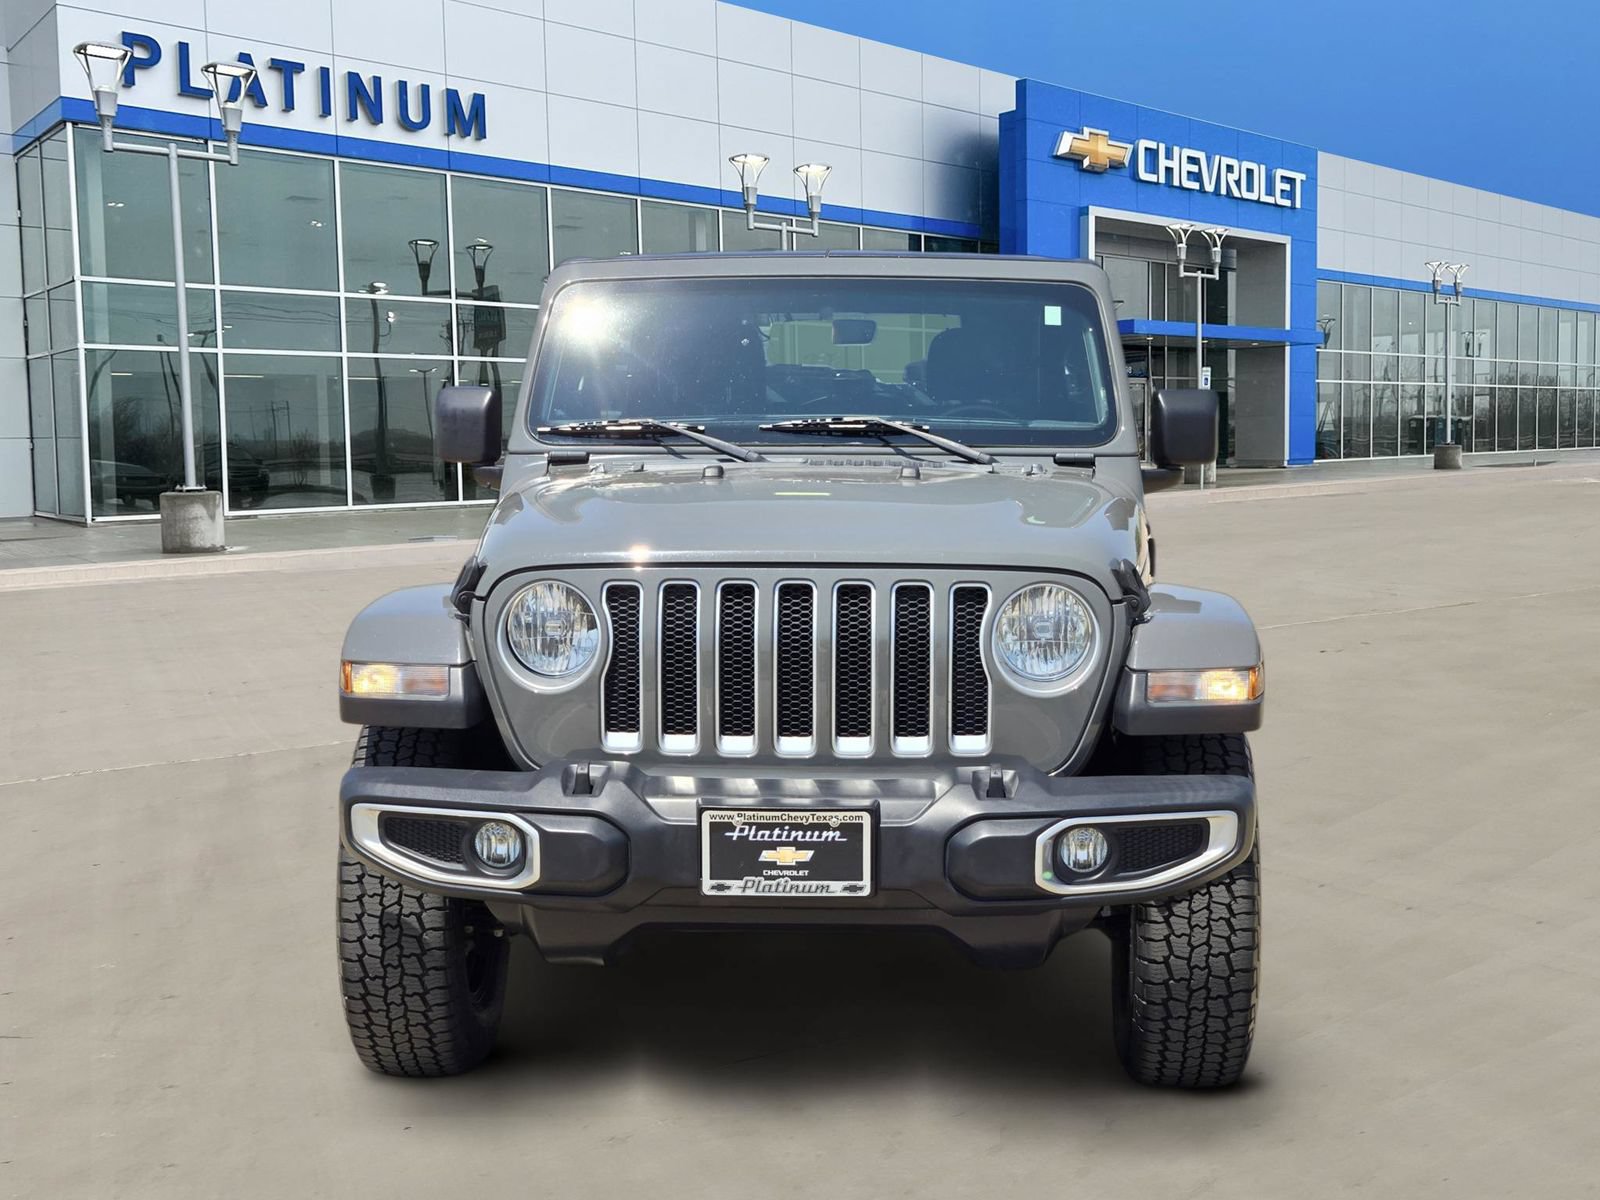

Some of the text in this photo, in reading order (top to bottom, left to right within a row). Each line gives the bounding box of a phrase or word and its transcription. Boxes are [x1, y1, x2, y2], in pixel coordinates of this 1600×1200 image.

[120, 31, 488, 140] PLATINUM
[1136, 138, 1306, 209] CHEVROLET
[709, 812, 863, 823] wwwPlatinumChevyTexas.com
[724, 825, 847, 841] Platinum
[762, 869, 809, 877] CHEVROLET
[738, 878, 836, 894] Platinum
